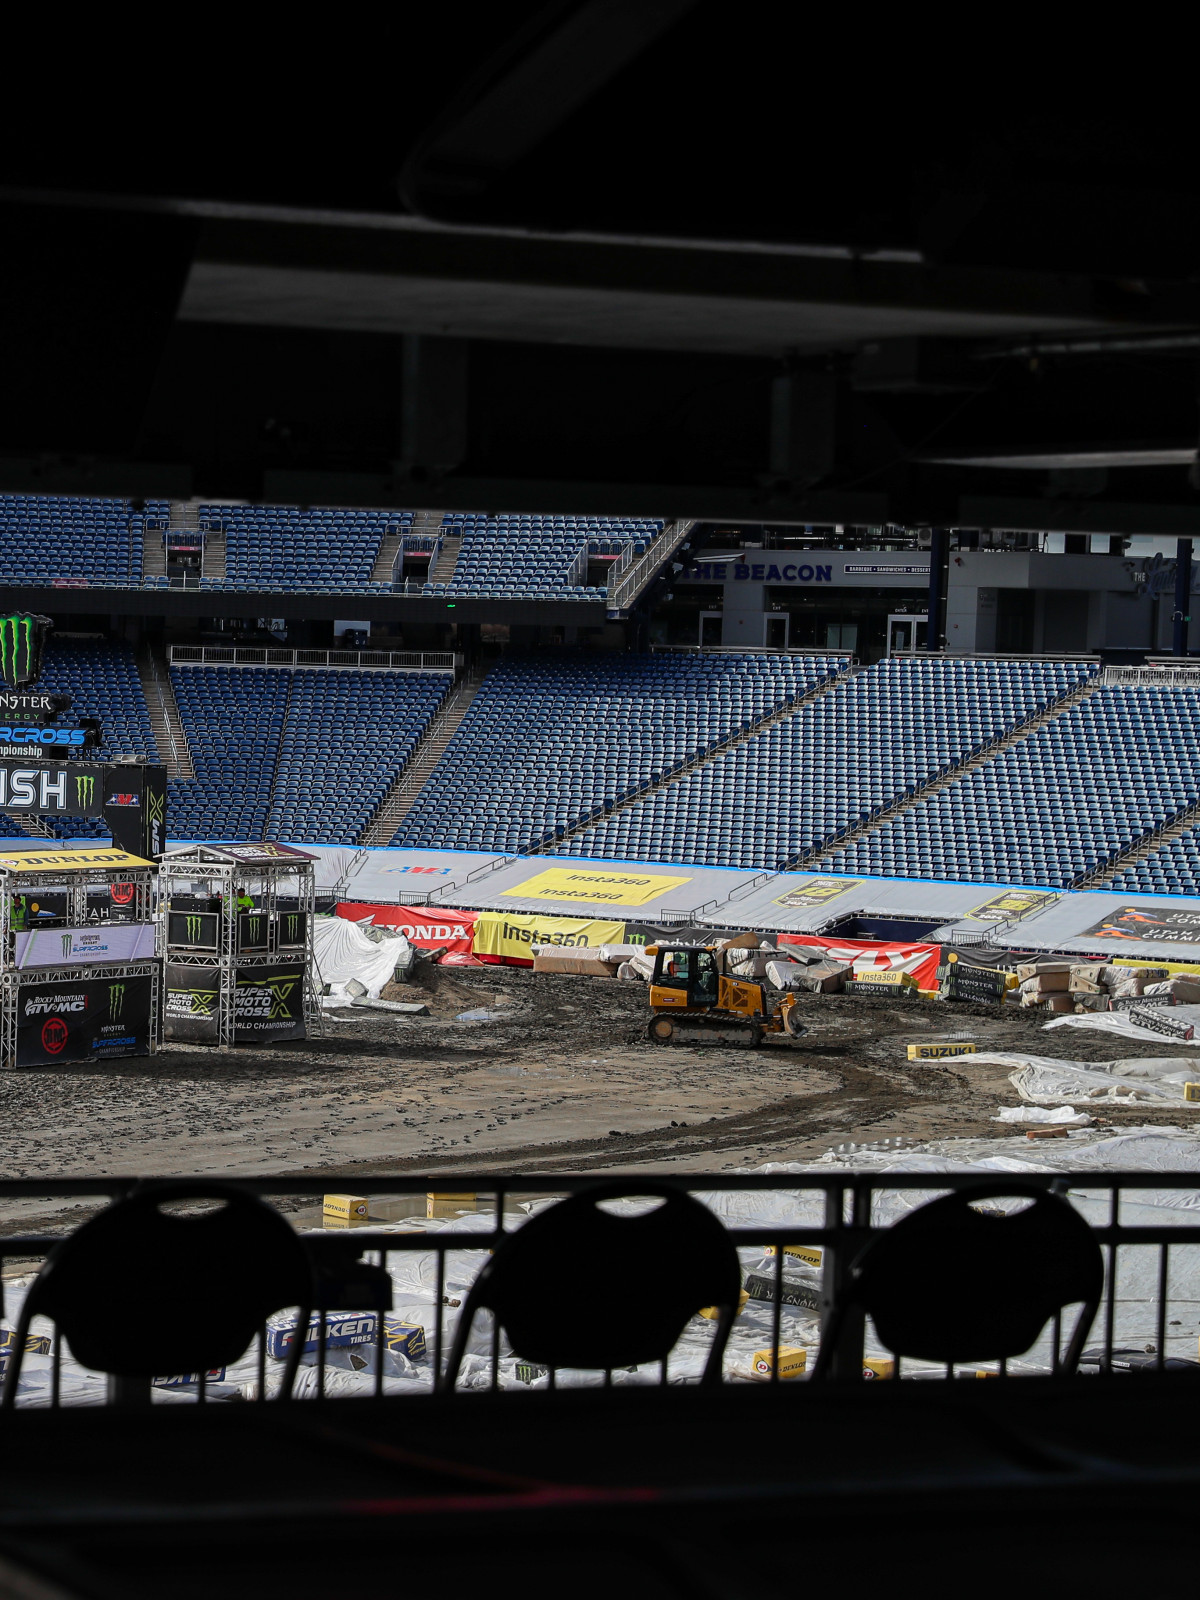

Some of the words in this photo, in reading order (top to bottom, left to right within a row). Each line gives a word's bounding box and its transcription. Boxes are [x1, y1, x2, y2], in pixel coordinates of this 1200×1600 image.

[734, 564, 833, 581] BEACON
[1134, 572, 1146, 582] THE
[20, 854, 130, 865] DUNLOP
[566, 874, 651, 886] Insta360
[539, 888, 623, 900] Insta360
[84, 907, 109, 919] TAH
[502, 921, 589, 947] Insta360
[861, 973, 897, 982] Insta360
[961, 966, 996, 979] MONSTER
[854, 983, 889, 993] MONSTER
[957, 978, 994, 989] MONSTER
[234, 987, 274, 997] SUPER
[33, 995, 54, 1003] ROCKY
[53, 994, 86, 1002] MOUNTAIN
[234, 997, 271, 1007] MOTO
[166, 1004, 192, 1012] CROSS
[100, 1024, 126, 1033] MONSTER
[254, 1021, 297, 1030] CHAMPIONSHIP
[91, 1037, 136, 1049] SUPERCROSS
[920, 1046, 972, 1058] SUZUKI
[324, 1203, 346, 1213] DUNLOP
[784, 1250, 820, 1264] DUNLOP
[350, 1334, 372, 1345] TIRES
